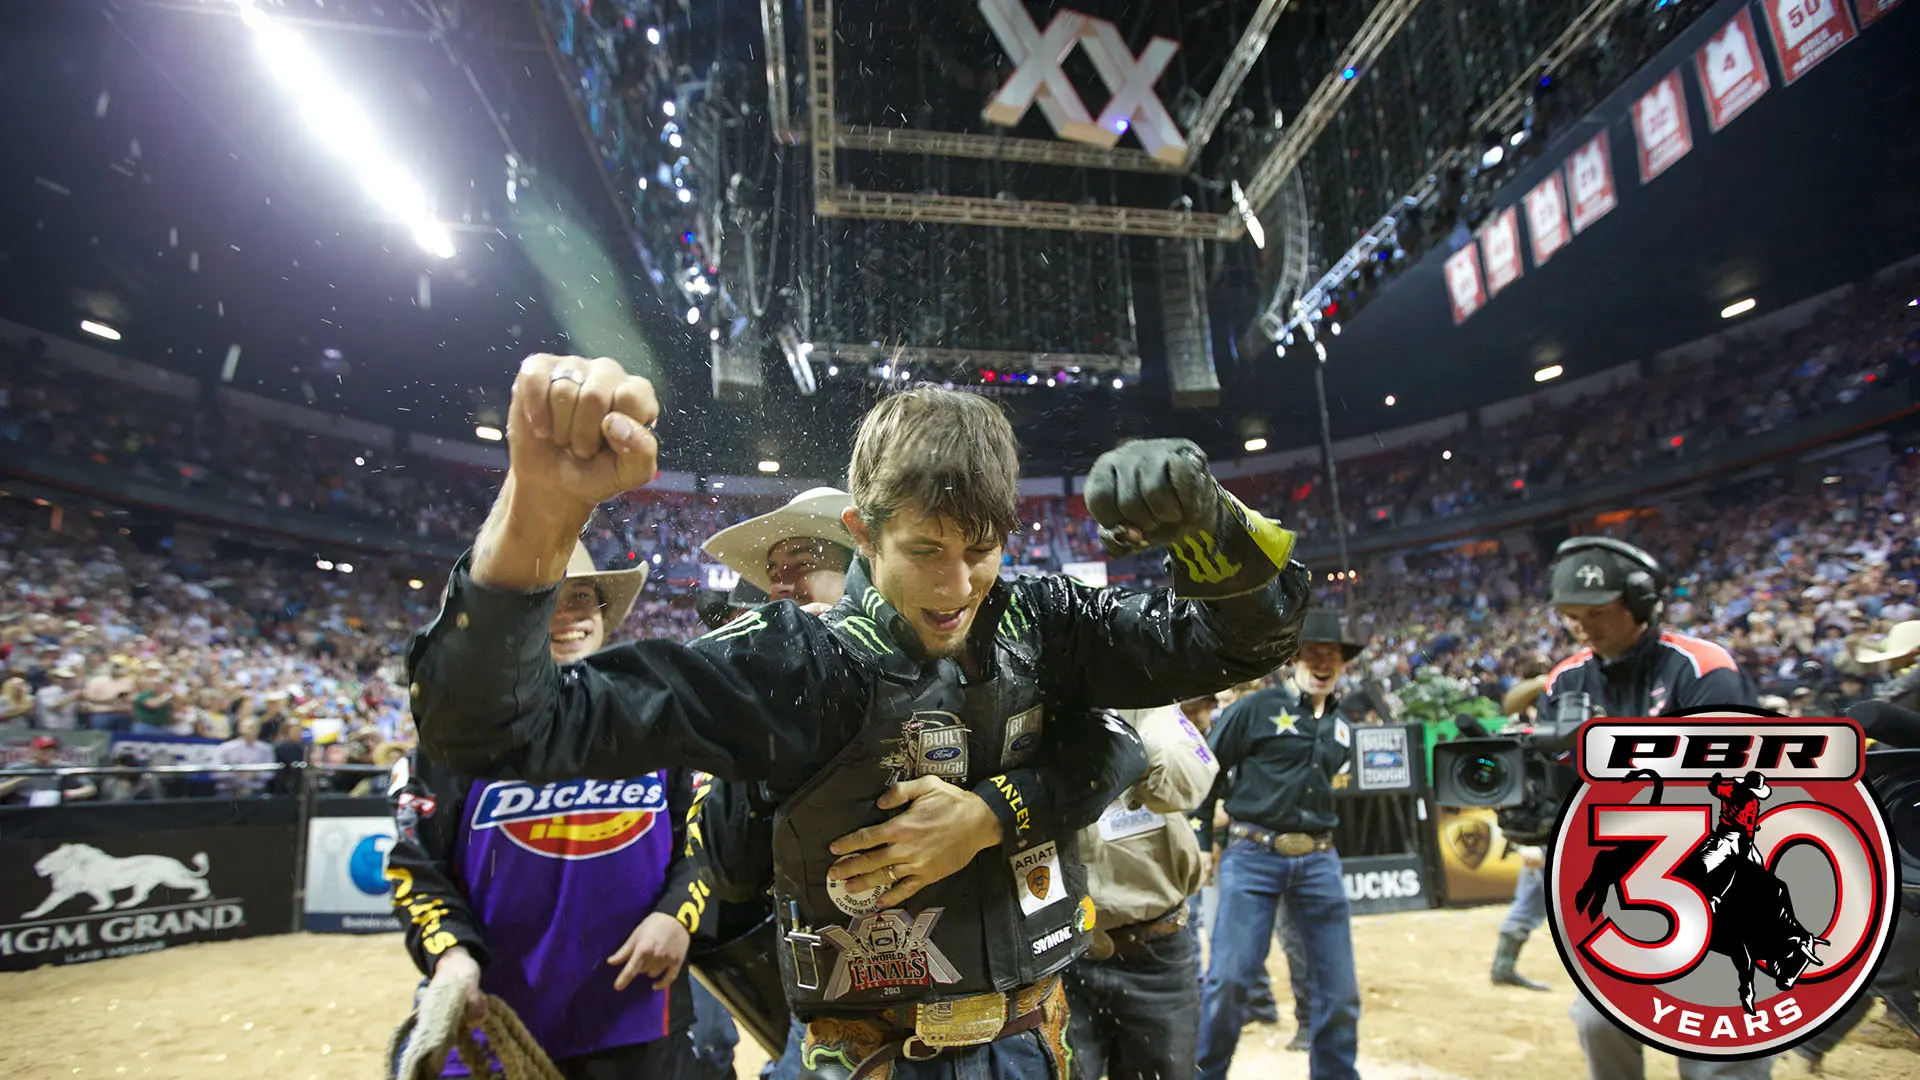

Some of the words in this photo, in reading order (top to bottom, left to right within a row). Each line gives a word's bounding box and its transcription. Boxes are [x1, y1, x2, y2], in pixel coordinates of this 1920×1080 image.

[978, 0, 1188, 166] XX
[923, 728, 962, 747] BUILT
[932, 750, 954, 760] Ford
[920, 761, 964, 775] TOUGH
[490, 779, 663, 817] Dickies
[1015, 846, 1055, 871] ARIAT
[835, 897, 864, 915] CUSTOM
[100, 904, 244, 943] GRAND
[870, 951, 905, 962] WORLD
[853, 957, 928, 986] FINALS
[883, 986, 902, 996] 2013
